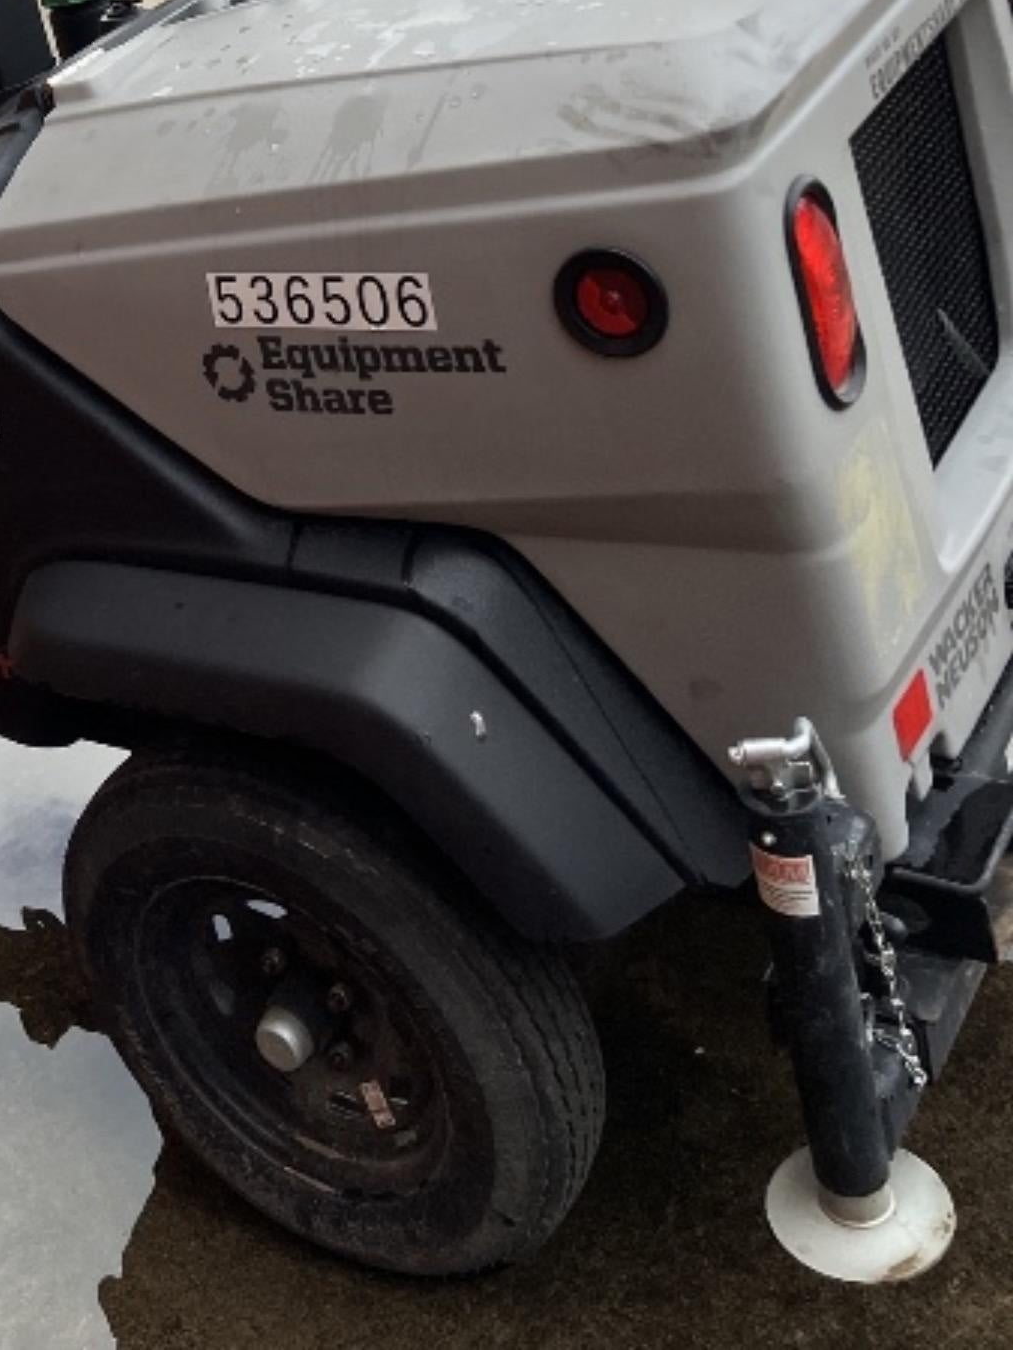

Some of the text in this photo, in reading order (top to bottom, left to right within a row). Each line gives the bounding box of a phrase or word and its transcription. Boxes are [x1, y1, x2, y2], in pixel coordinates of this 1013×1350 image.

[213, 274, 431, 330] 536506
[258, 335, 507, 378] Equipment
[266, 378, 394, 416] Share
[928, 562, 994, 674] WACKER
[935, 587, 1001, 710] NEUSON
